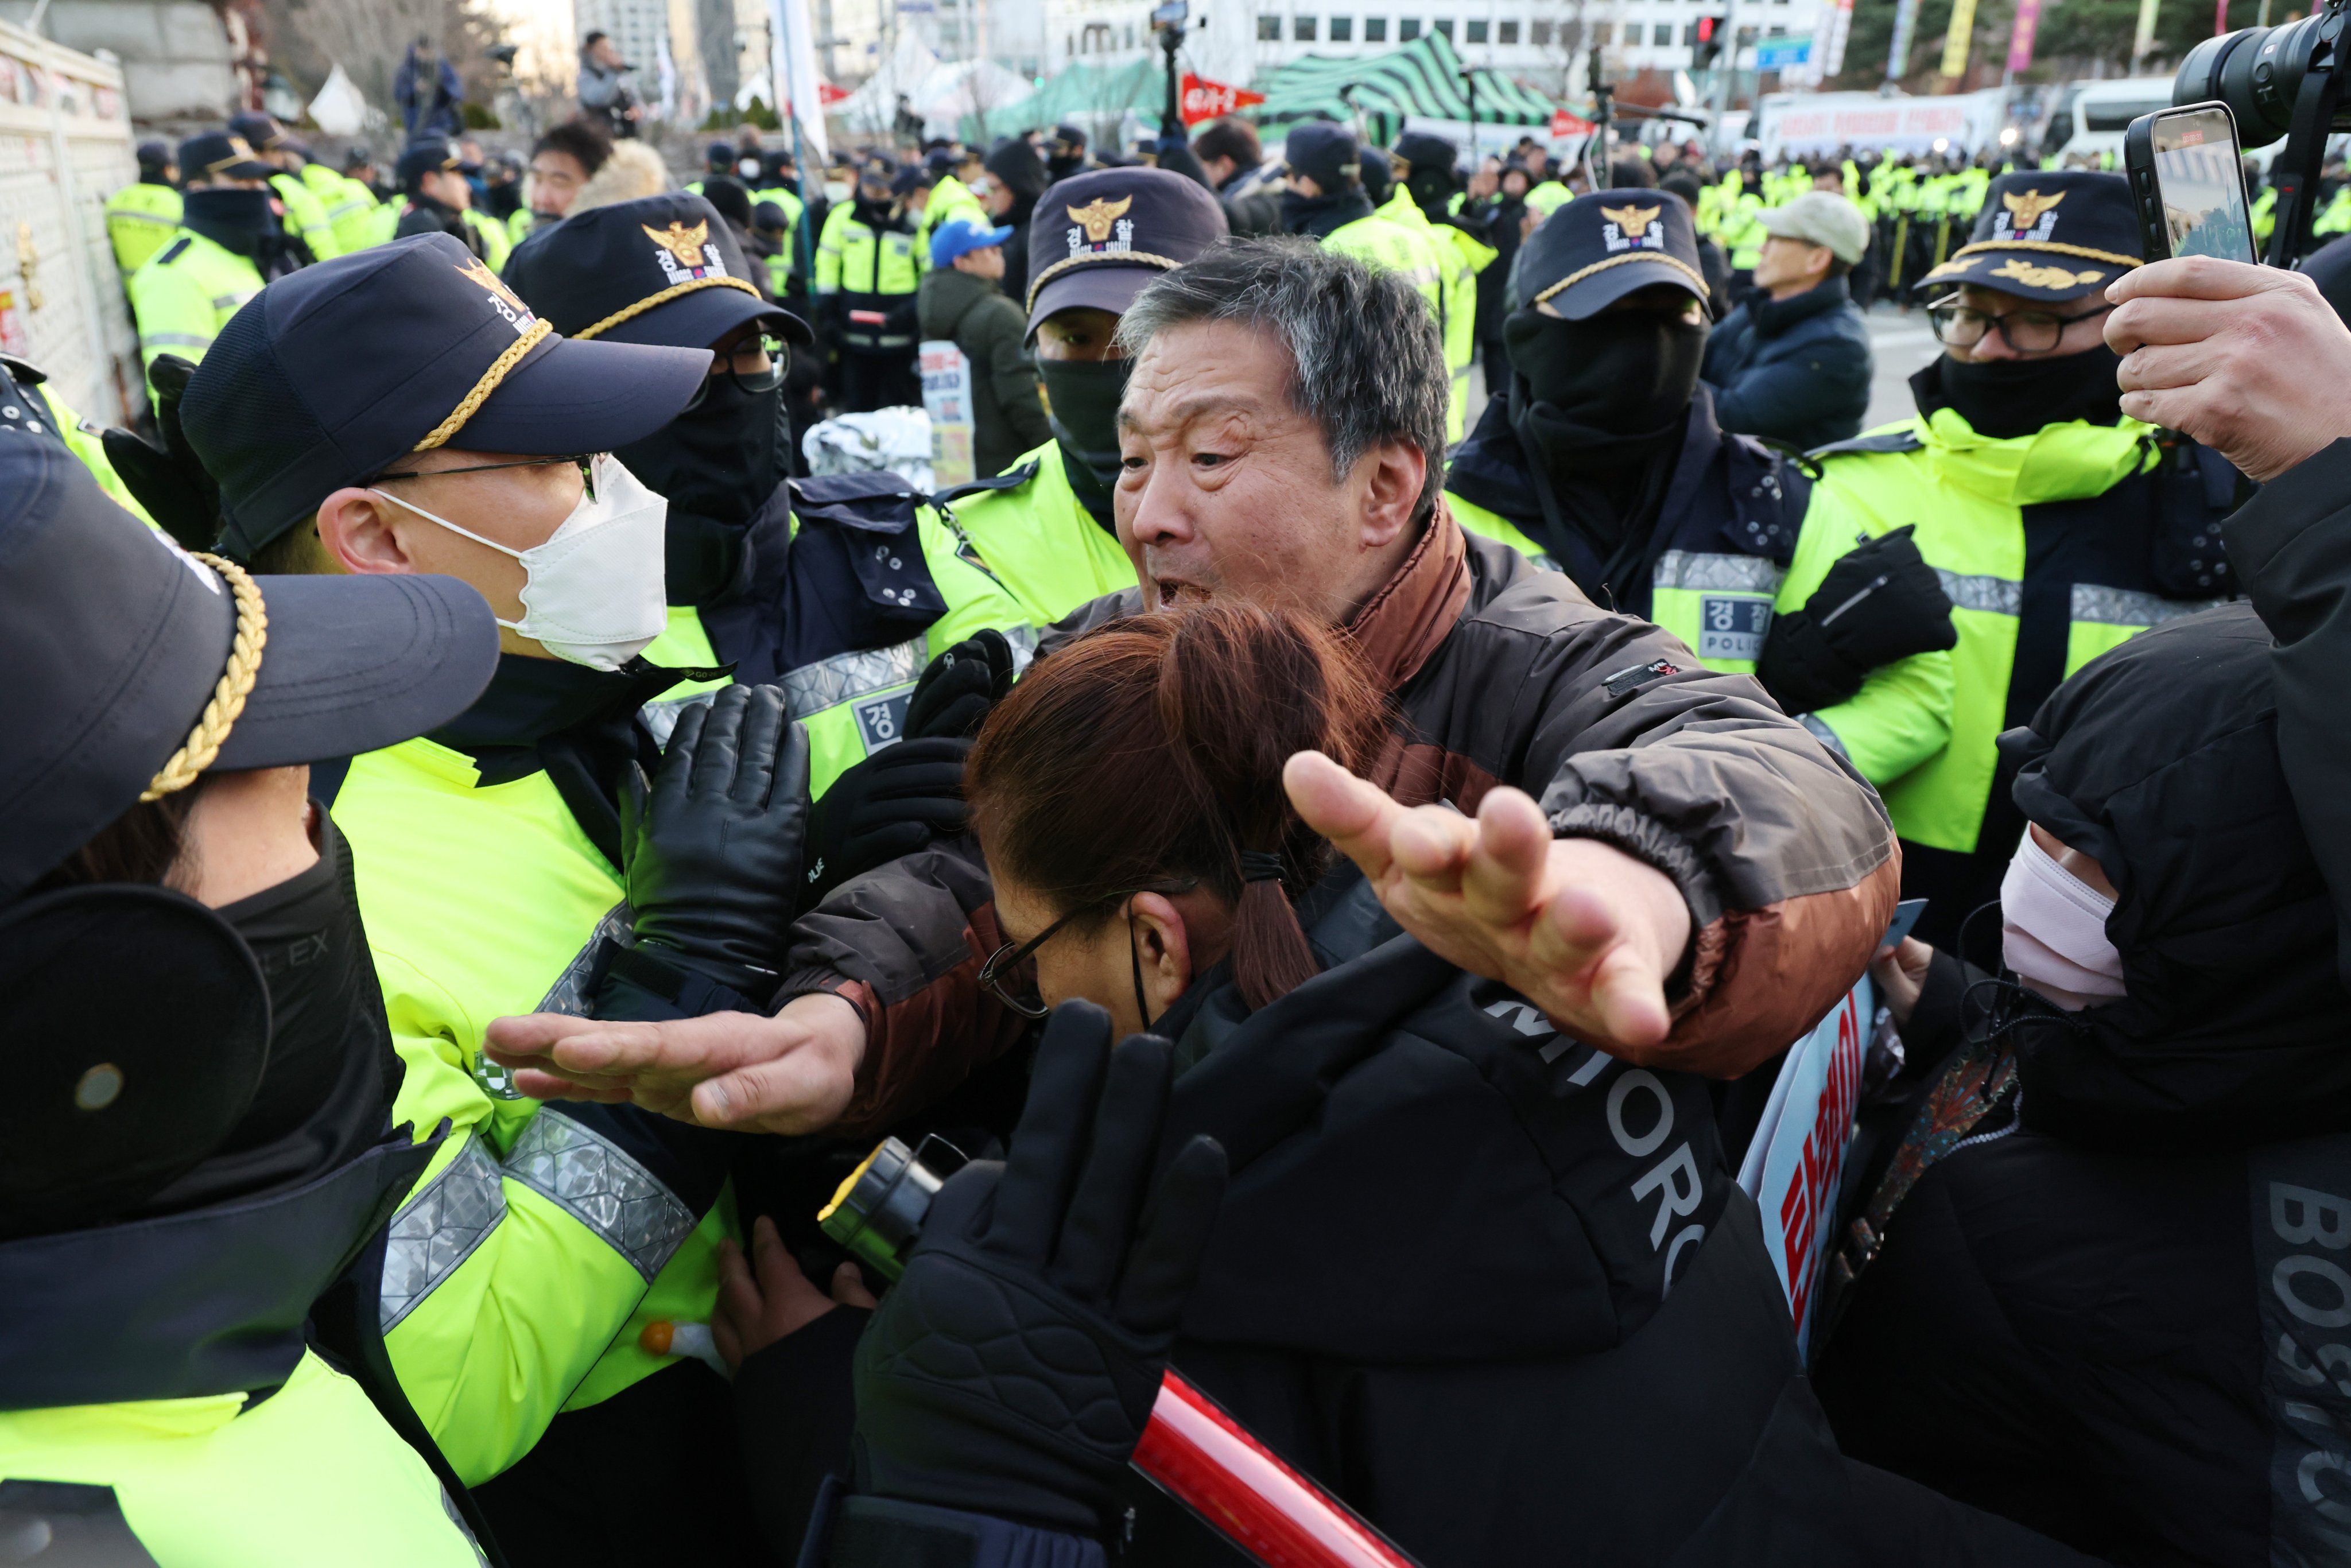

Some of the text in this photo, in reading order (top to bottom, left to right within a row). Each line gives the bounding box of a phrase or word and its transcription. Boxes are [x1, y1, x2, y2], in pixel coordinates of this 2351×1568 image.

[487, 292, 517, 323] 경
[1709, 601, 1733, 631] 경
[865, 703, 891, 739] 경
